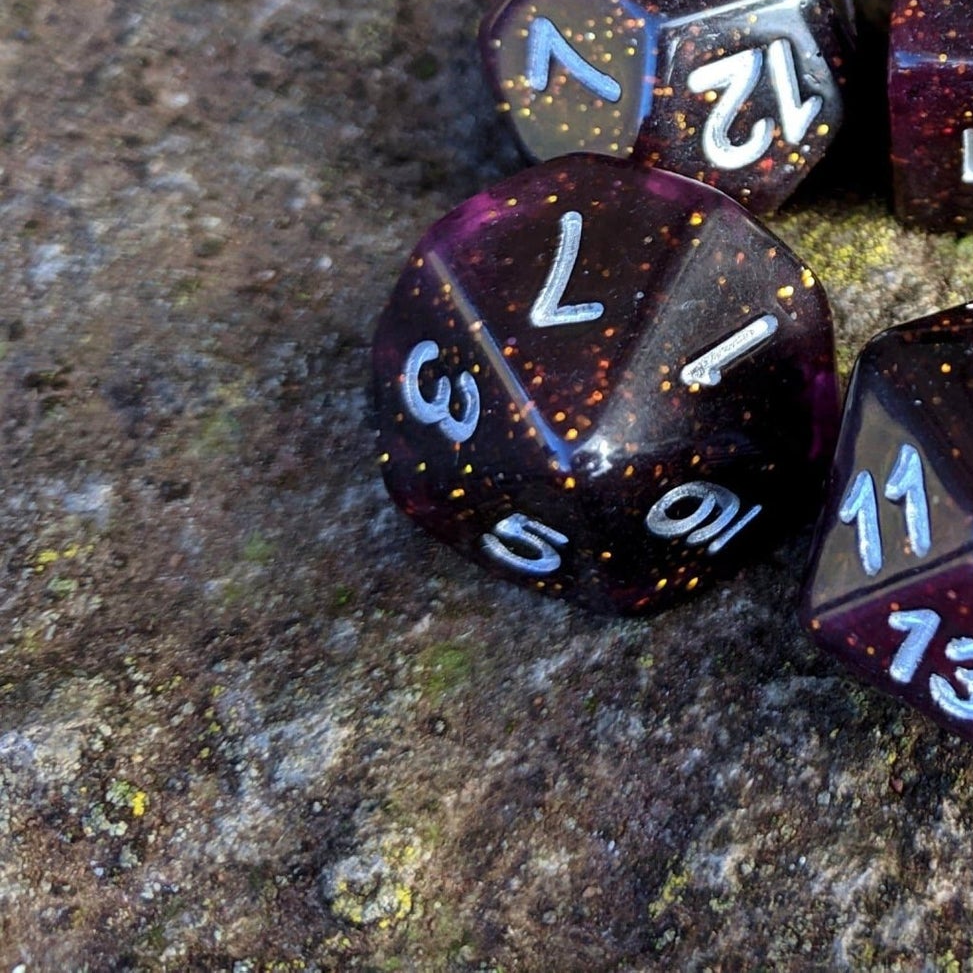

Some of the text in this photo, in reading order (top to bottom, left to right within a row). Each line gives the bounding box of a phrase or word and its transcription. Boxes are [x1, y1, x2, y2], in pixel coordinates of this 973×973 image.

[525, 16, 622, 103] 7
[687, 38, 823, 170] 12
[530, 211, 604, 327] 7
[403, 340, 480, 443] 3
[681, 313, 778, 387] 1
[480, 512, 569, 574] 5
[839, 443, 932, 577] 11
